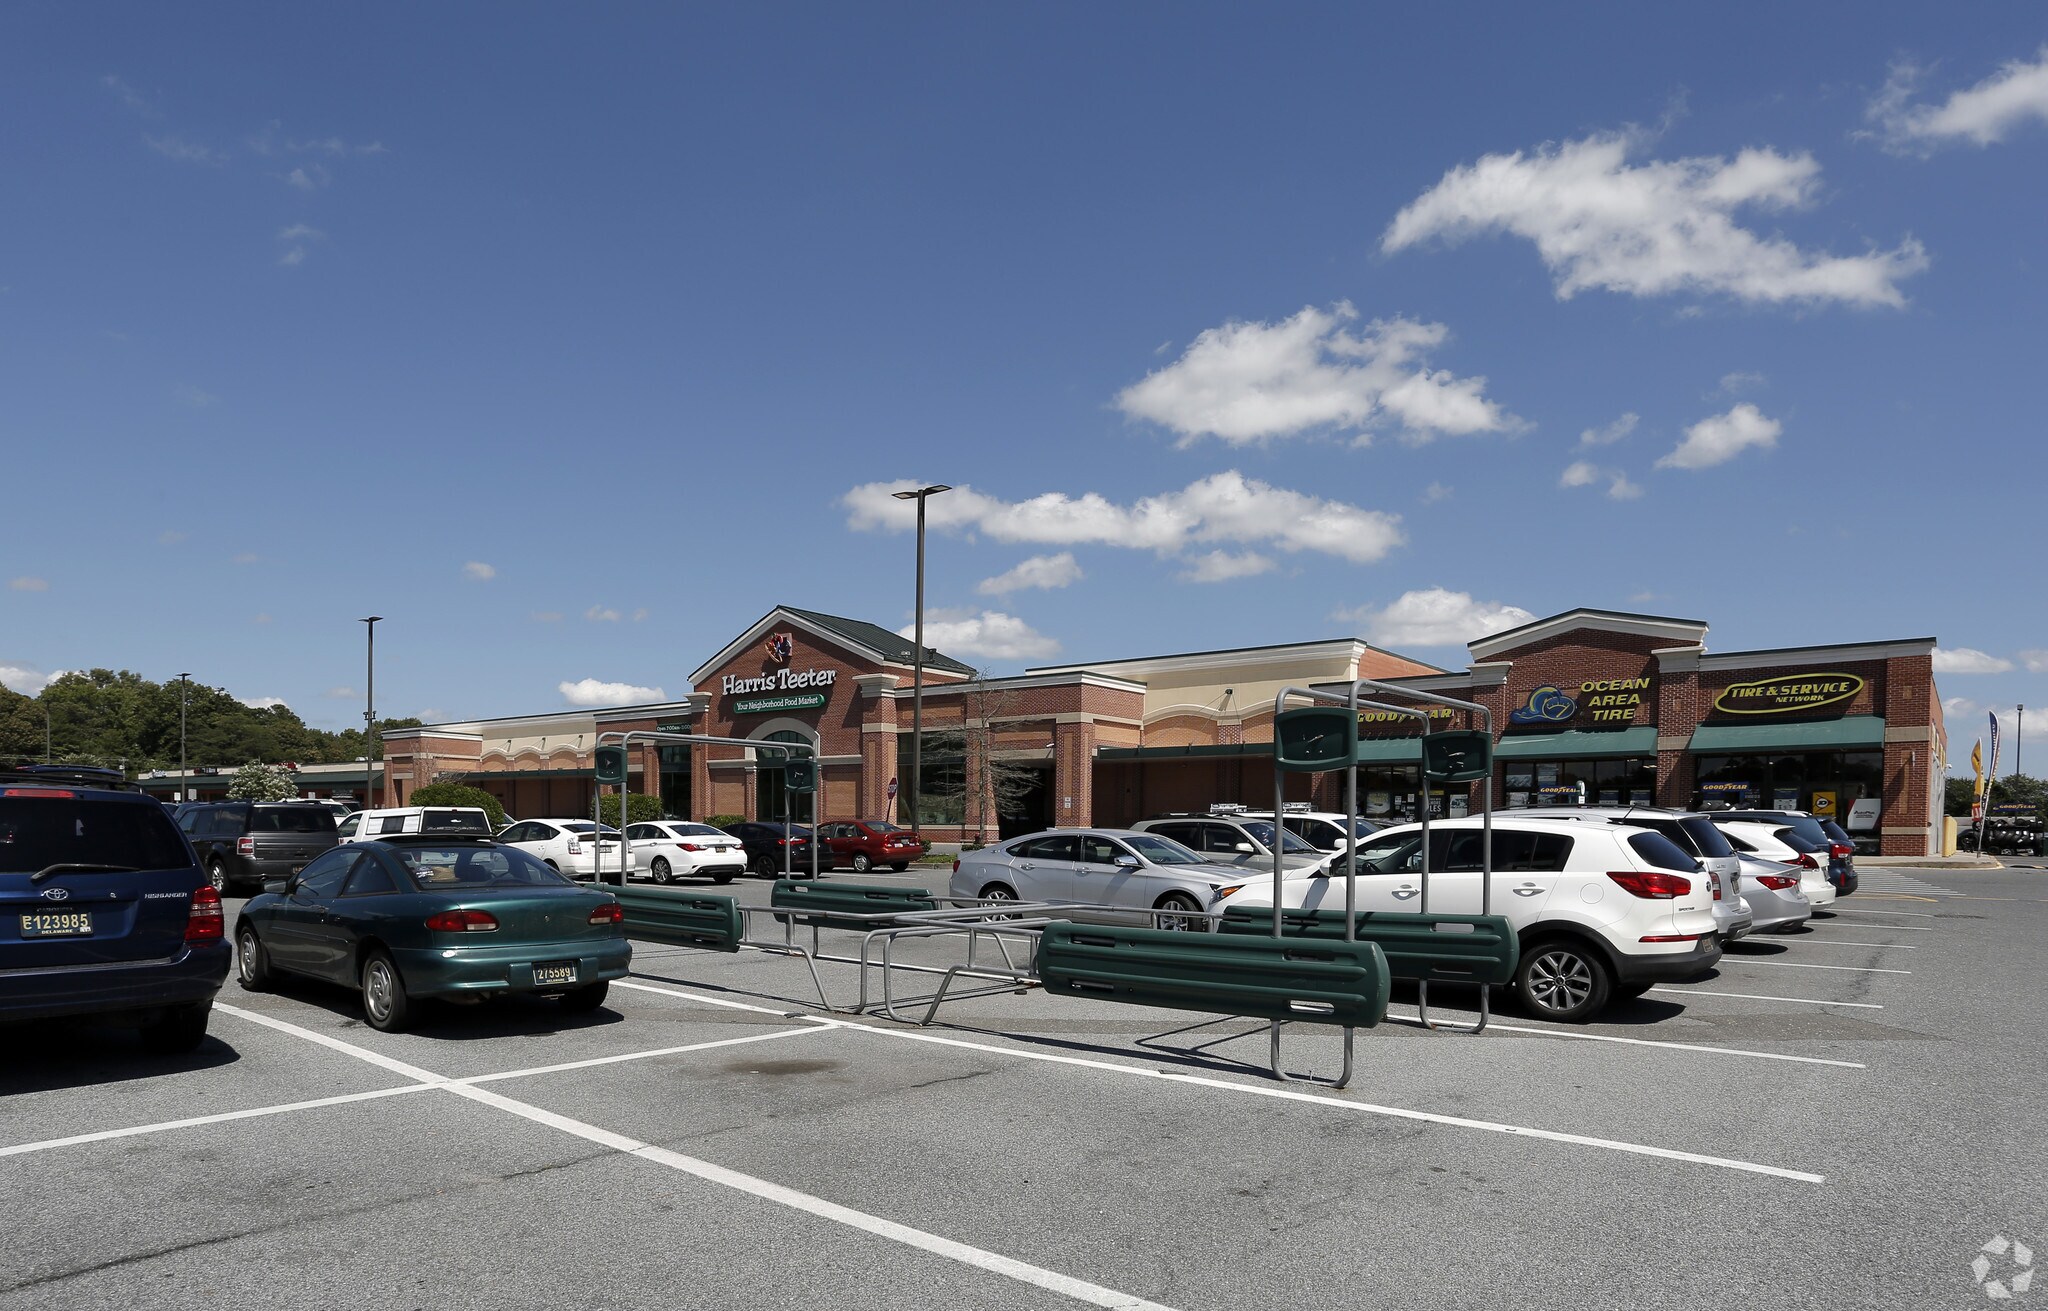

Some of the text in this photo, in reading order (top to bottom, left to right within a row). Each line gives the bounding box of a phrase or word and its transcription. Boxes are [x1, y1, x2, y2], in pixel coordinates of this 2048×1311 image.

[722, 668, 836, 696] Harris Teeter
[1581, 678, 1650, 692] OCEAN
[1732, 682, 1850, 698] TIRE & SERVICE
[737, 697, 818, 711] Your Neighborhood Food Market
[1588, 693, 1640, 707] AREA
[1775, 694, 1825, 703] NETWORK
[1592, 708, 1635, 721] TIRE
[1702, 783, 1748, 791] GOODYEAR
[538, 967, 570, 979] 275589
